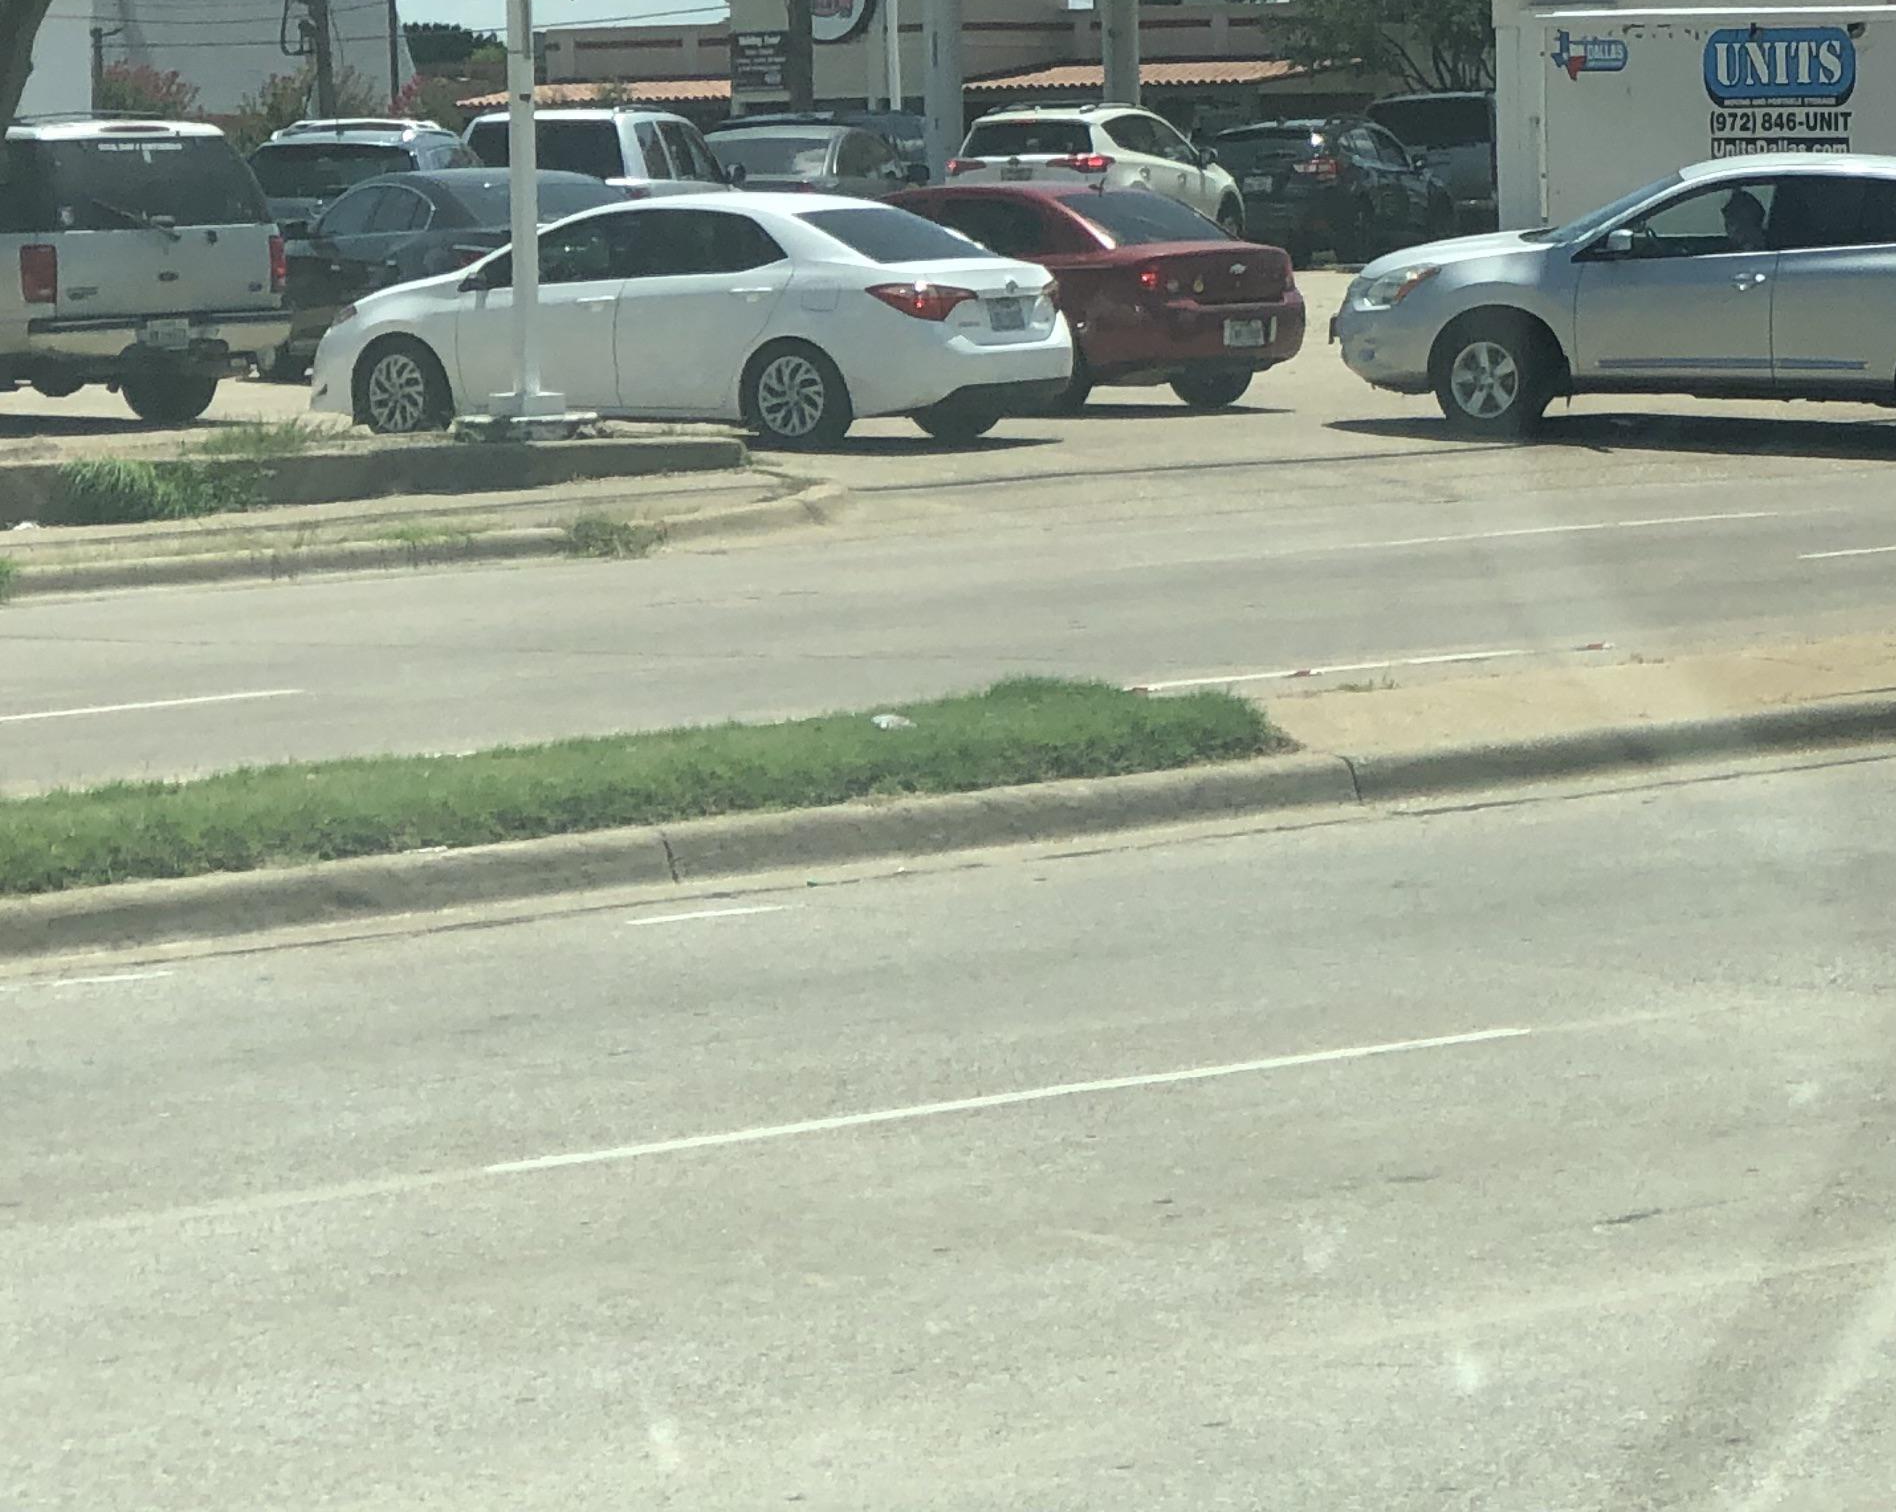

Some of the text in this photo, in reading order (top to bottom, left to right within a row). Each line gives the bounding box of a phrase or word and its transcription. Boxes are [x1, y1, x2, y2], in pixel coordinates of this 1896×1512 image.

[1587, 43, 1624, 59] DALLAS
[1714, 40, 1843, 87] UNITS
[1710, 111, 1852, 134] (972) 846-UNIT
